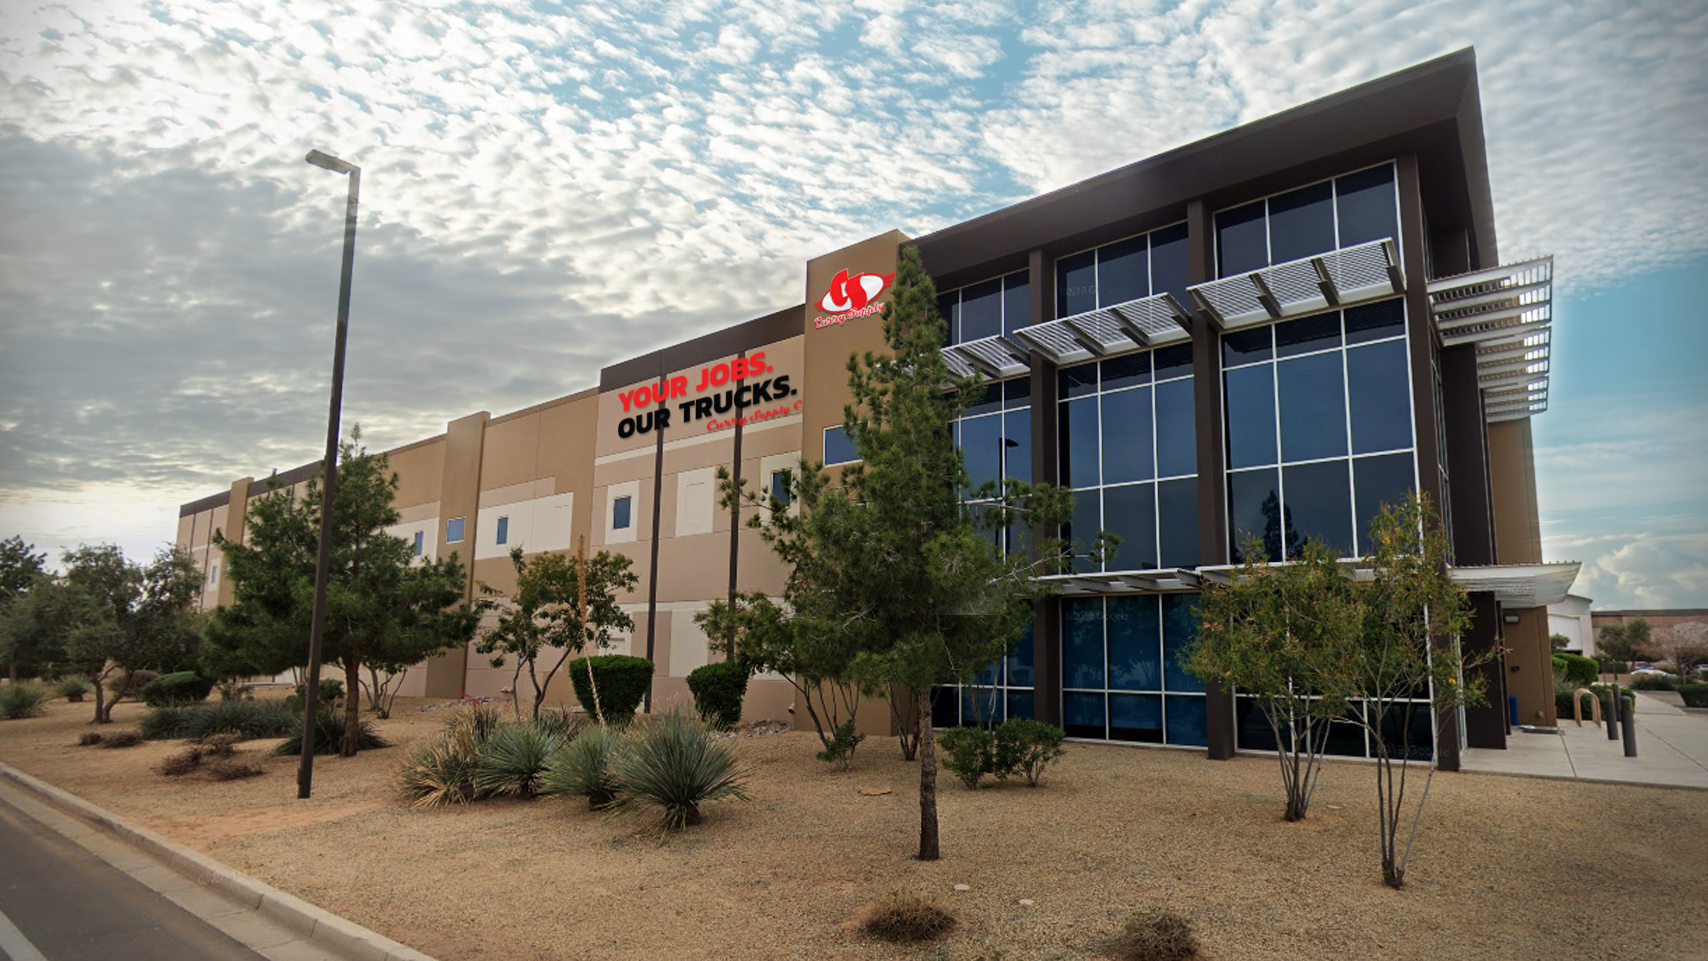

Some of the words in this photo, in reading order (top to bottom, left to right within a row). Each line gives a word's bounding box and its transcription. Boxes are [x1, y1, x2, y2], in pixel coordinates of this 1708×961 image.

[814, 312, 846, 328] Curry
[846, 302, 885, 319] Supply
[618, 375, 688, 412] YOUR
[695, 351, 774, 392] JOBS.
[617, 408, 671, 439] OUR
[678, 375, 798, 423] TRUCKS.
[706, 416, 747, 431] Curry
[749, 405, 791, 421] Supply
